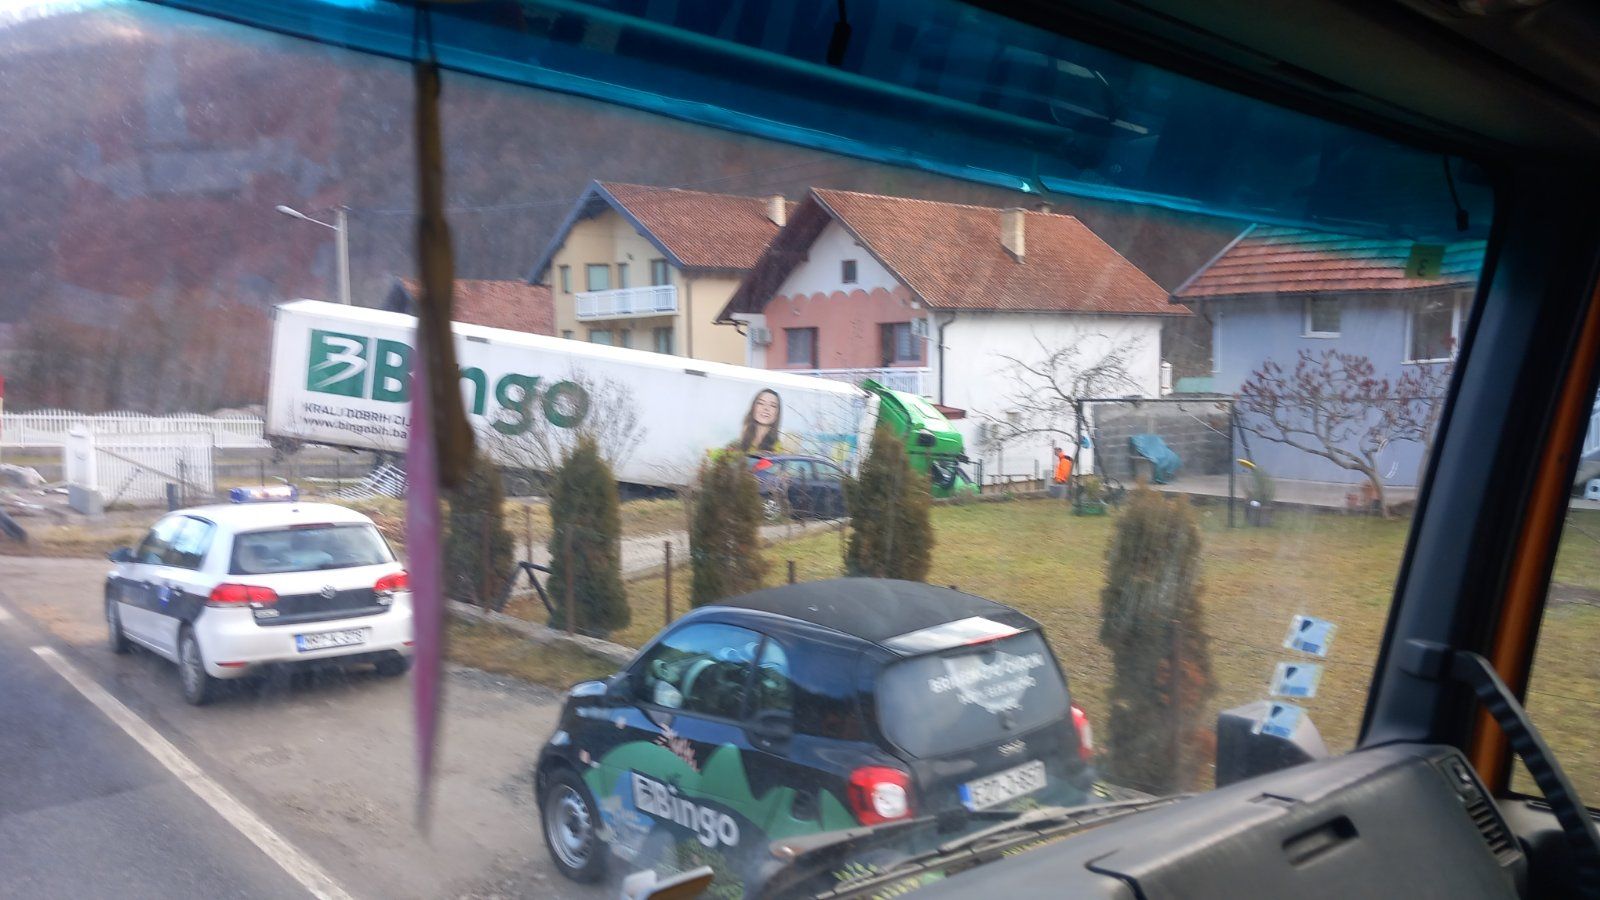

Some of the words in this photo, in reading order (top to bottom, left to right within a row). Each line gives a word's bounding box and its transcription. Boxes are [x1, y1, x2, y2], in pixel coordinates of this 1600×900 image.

[371, 338, 589, 436] Bngo
[303, 417, 408, 439] www.bingobih.ba
[393, 413, 412, 427] CIJ
[655, 779, 740, 848] Bingo
